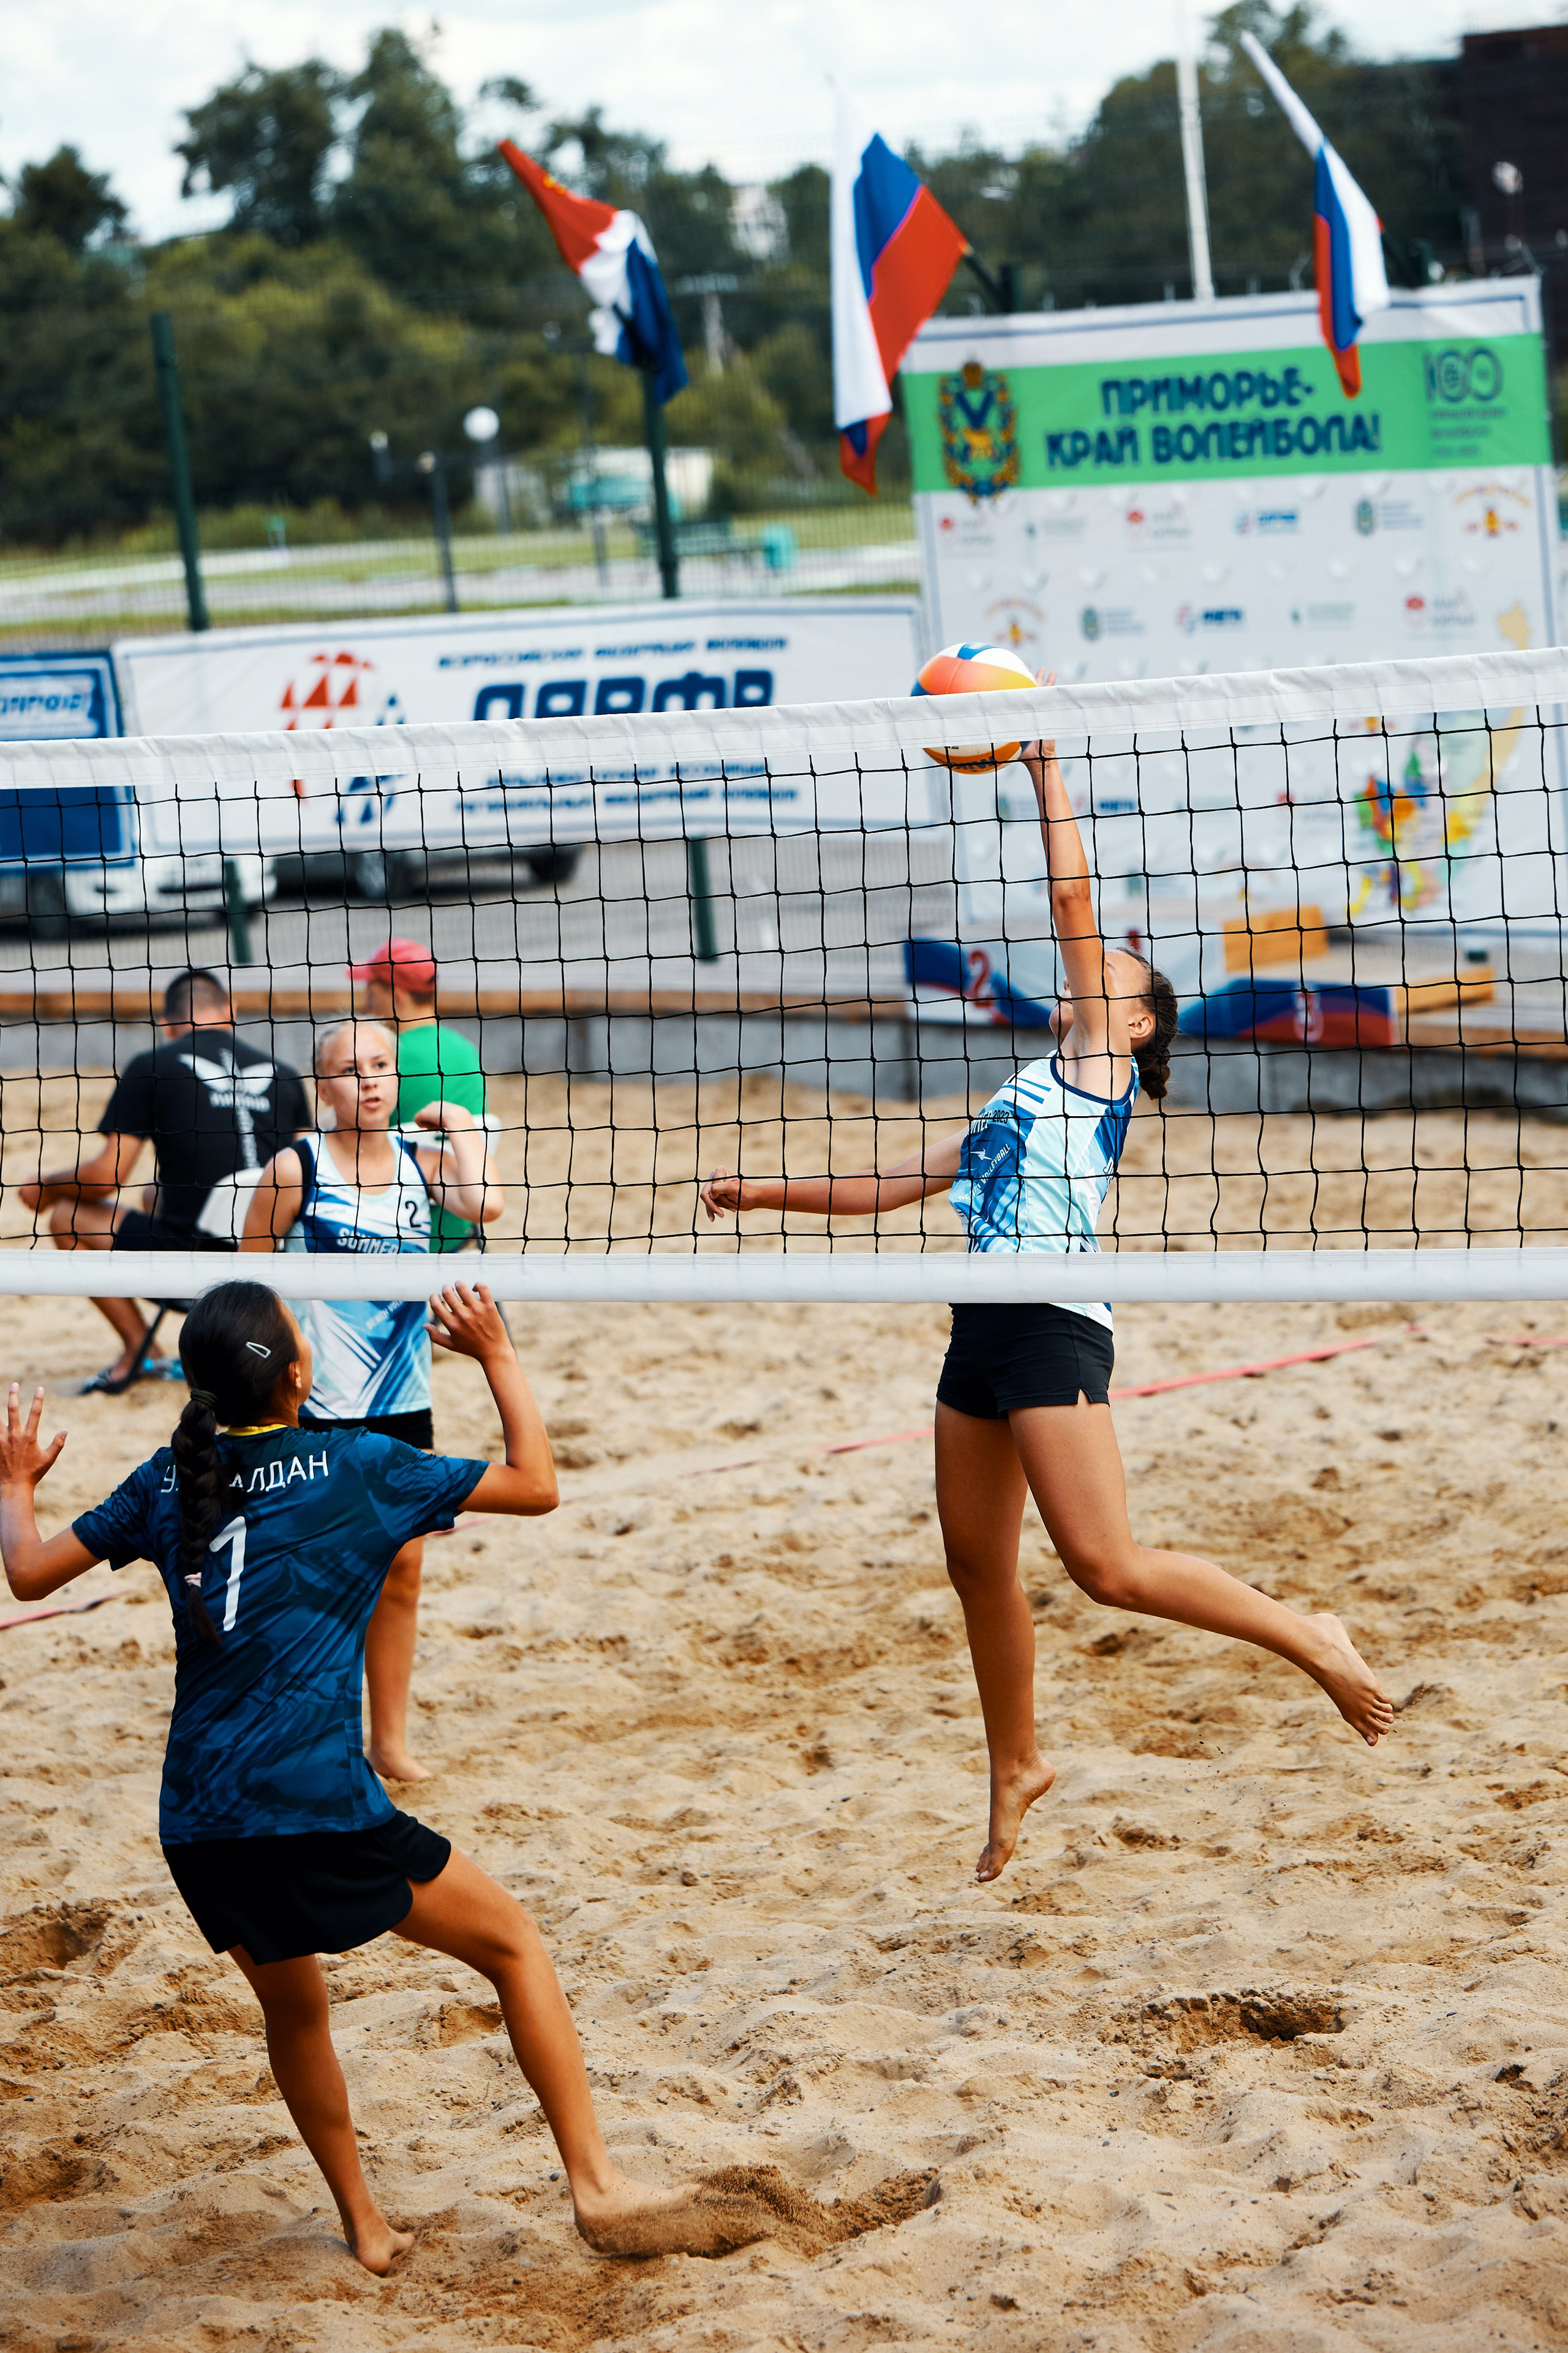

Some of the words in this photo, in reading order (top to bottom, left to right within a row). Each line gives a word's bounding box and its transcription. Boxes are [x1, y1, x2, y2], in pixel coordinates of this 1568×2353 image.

[1047, 428, 1138, 466] КРАЙ
[1153, 414, 1381, 464] ВОЛЕЙБОЛА!
[969, 951, 993, 1010] 2
[992, 1109, 1009, 1124] 2023
[405, 1201, 421, 1228] 2
